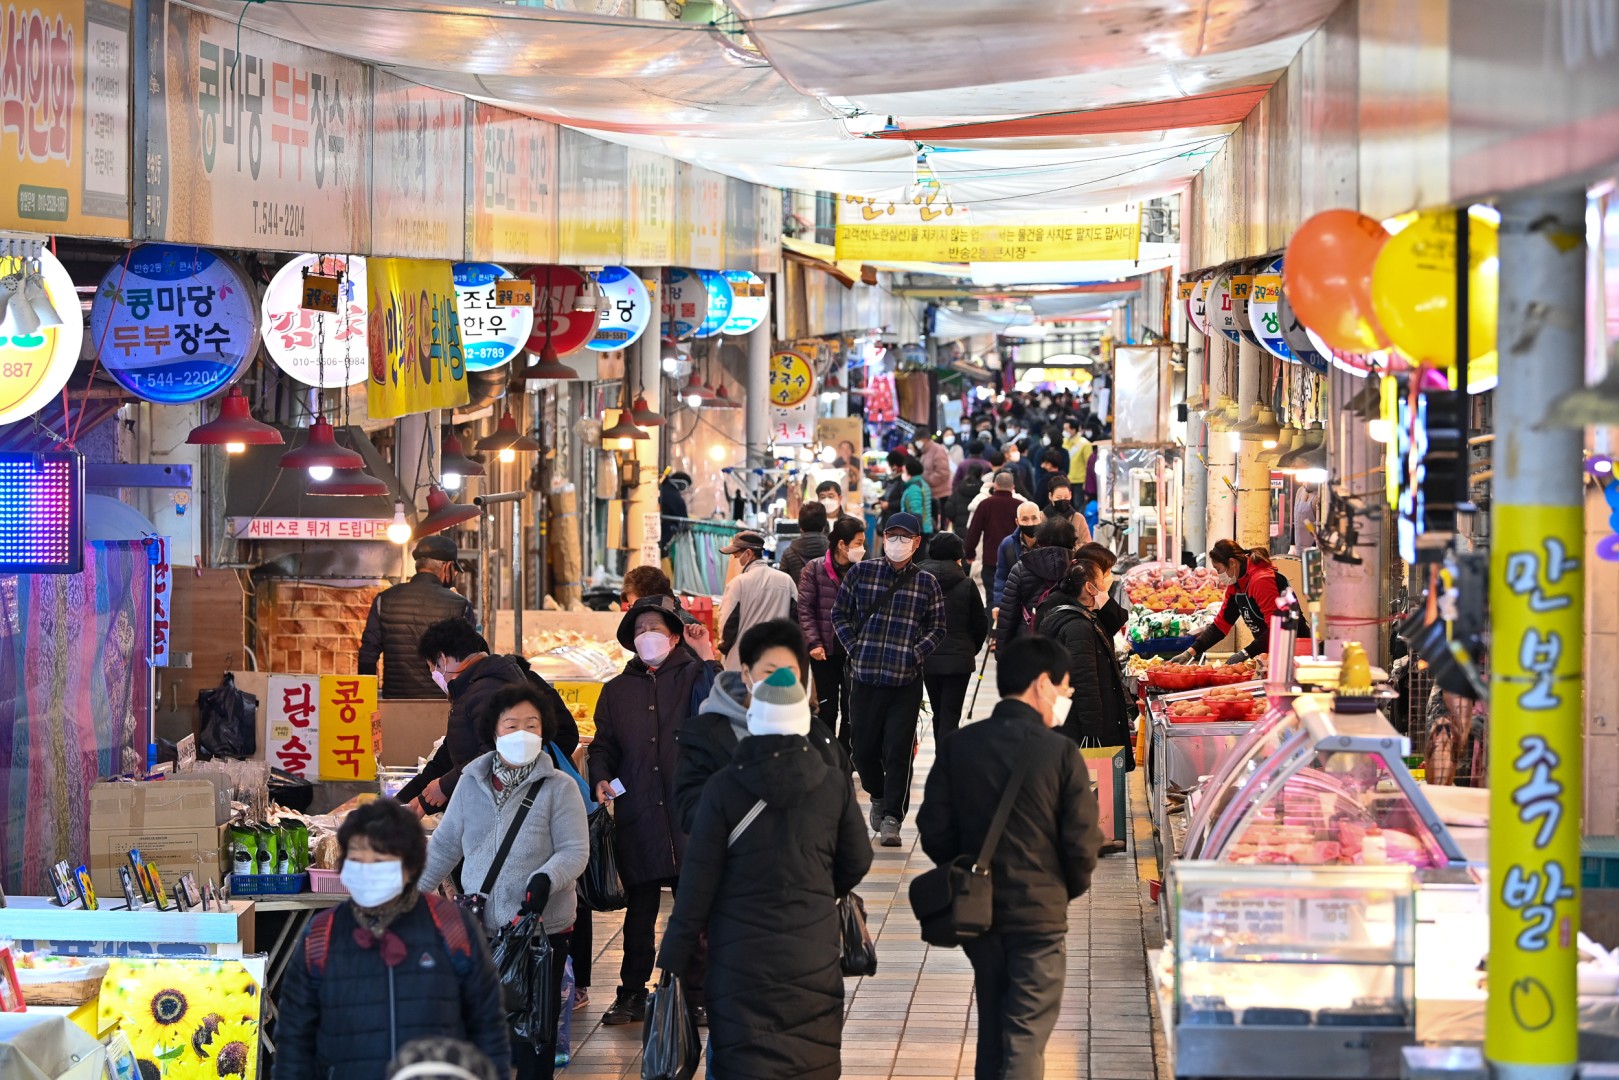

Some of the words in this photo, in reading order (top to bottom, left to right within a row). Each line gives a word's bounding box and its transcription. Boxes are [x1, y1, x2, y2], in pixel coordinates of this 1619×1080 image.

[0, 5, 76, 166] 석인화
[199, 40, 265, 181] 콩마당
[252, 200, 305, 238] T.544-2204
[921, 229, 948, 242] 지키지
[951, 229, 968, 242] 않는
[970, 228, 1015, 242] 업서는
[1018, 228, 1044, 242] 물건을
[1046, 228, 1073, 242] 사지도
[1076, 228, 1102, 241] 팔지도
[134, 262, 162, 274] 반송2동
[180, 261, 202, 272] 큰시장
[127, 285, 216, 320] 콩마당
[456, 289, 505, 309] 조은
[498, 290, 513, 304] 골목
[1255, 286, 1266, 299] 골목
[464, 316, 507, 336] 한우
[114, 323, 231, 357] 두부장수
[293, 356, 365, 367] 010-5606-984
[132, 371, 219, 387] T.544-2204
[250, 520, 298, 537] 서비스로
[307, 520, 331, 537] 튀겨
[331, 680, 365, 778] 콩국
